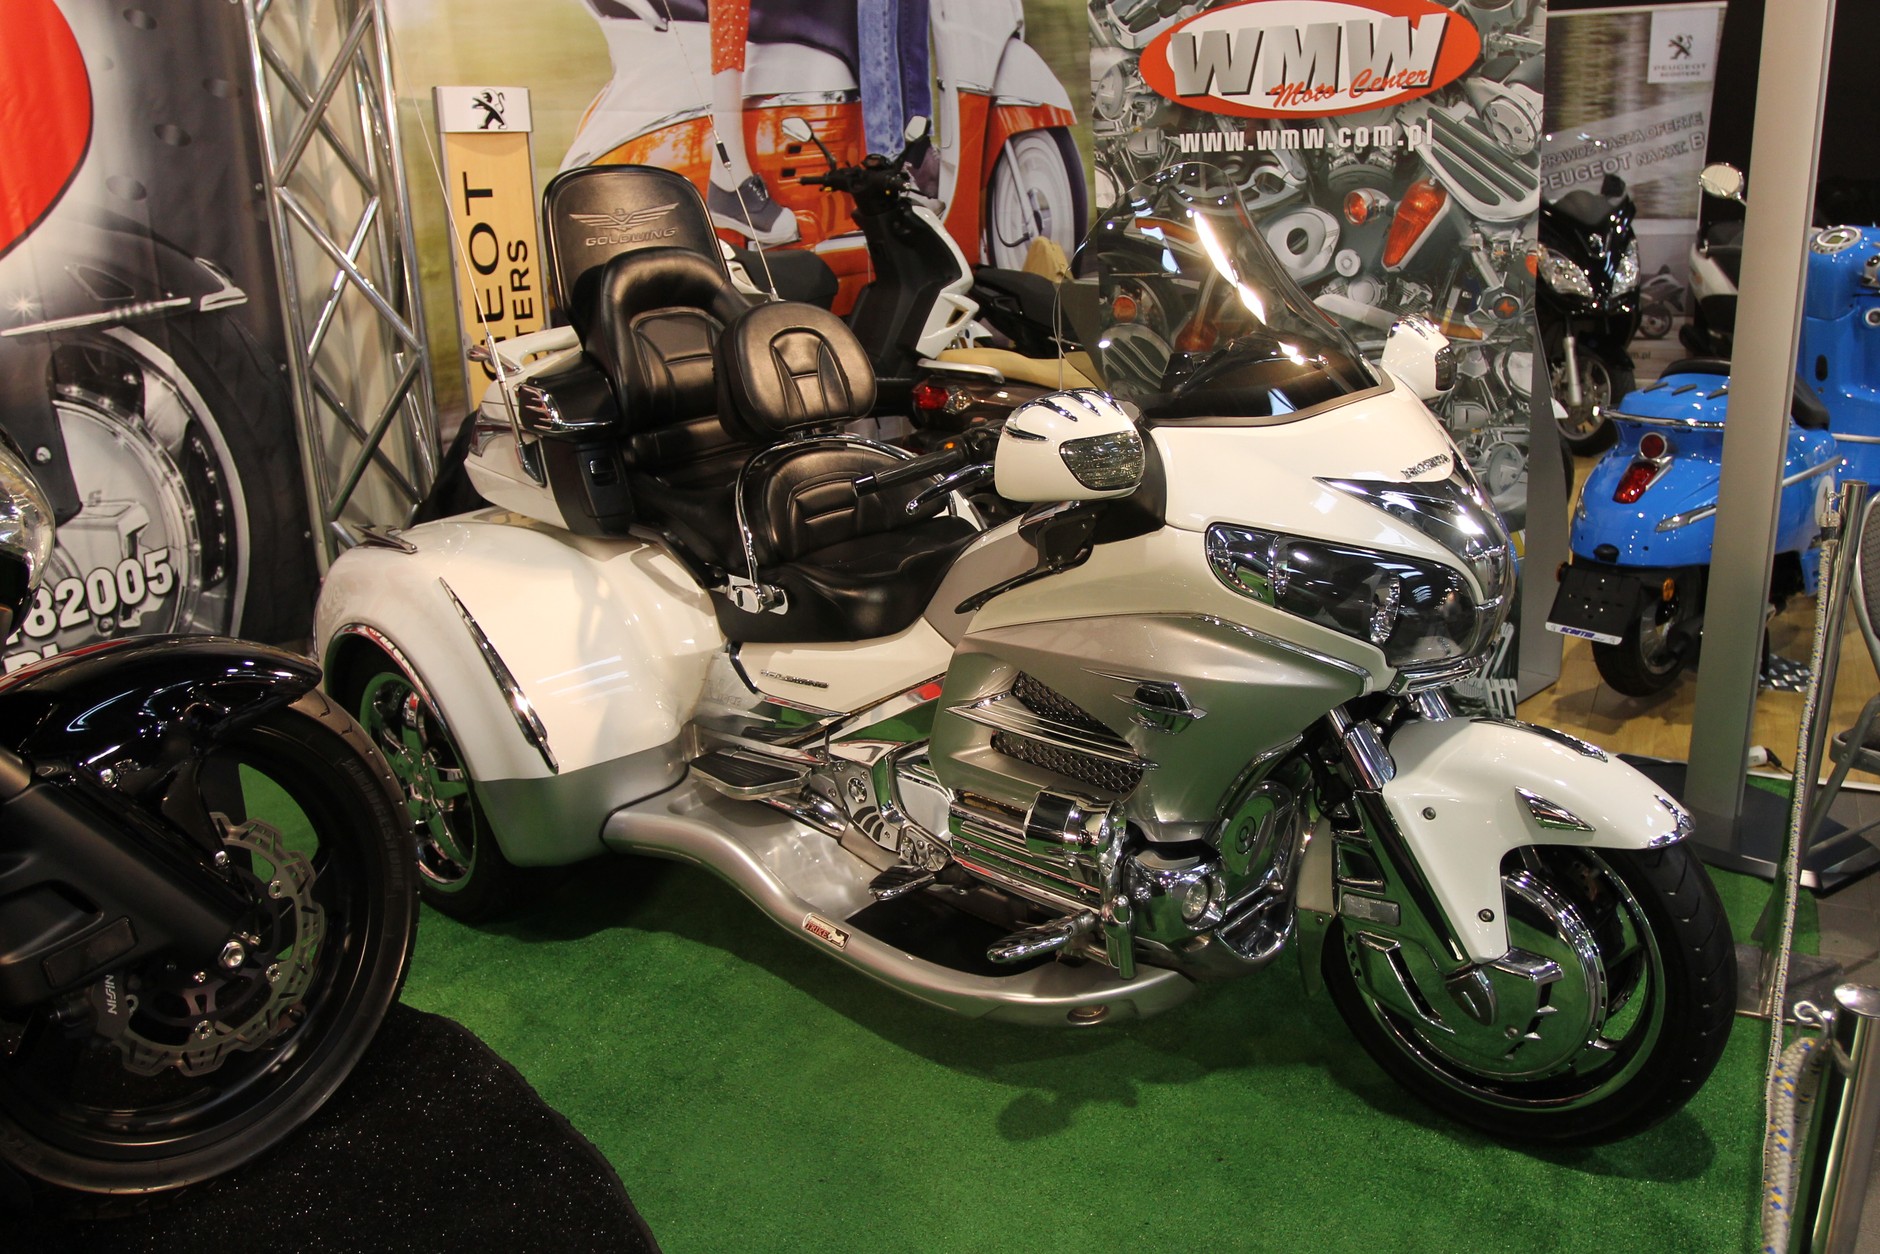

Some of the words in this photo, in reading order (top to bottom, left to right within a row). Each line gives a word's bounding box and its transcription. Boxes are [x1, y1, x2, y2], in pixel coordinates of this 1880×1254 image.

[1171, 13, 1449, 96] WMW
[1180, 119, 1433, 153] www.wmw.com.pl
[1540, 152, 1632, 191] PEUGEOT
[1689, 131, 1706, 150] B
[585, 228, 677, 246] GOLDWING
[6, 549, 173, 645] 82005
[104, 974, 118, 1015] NISSIN
